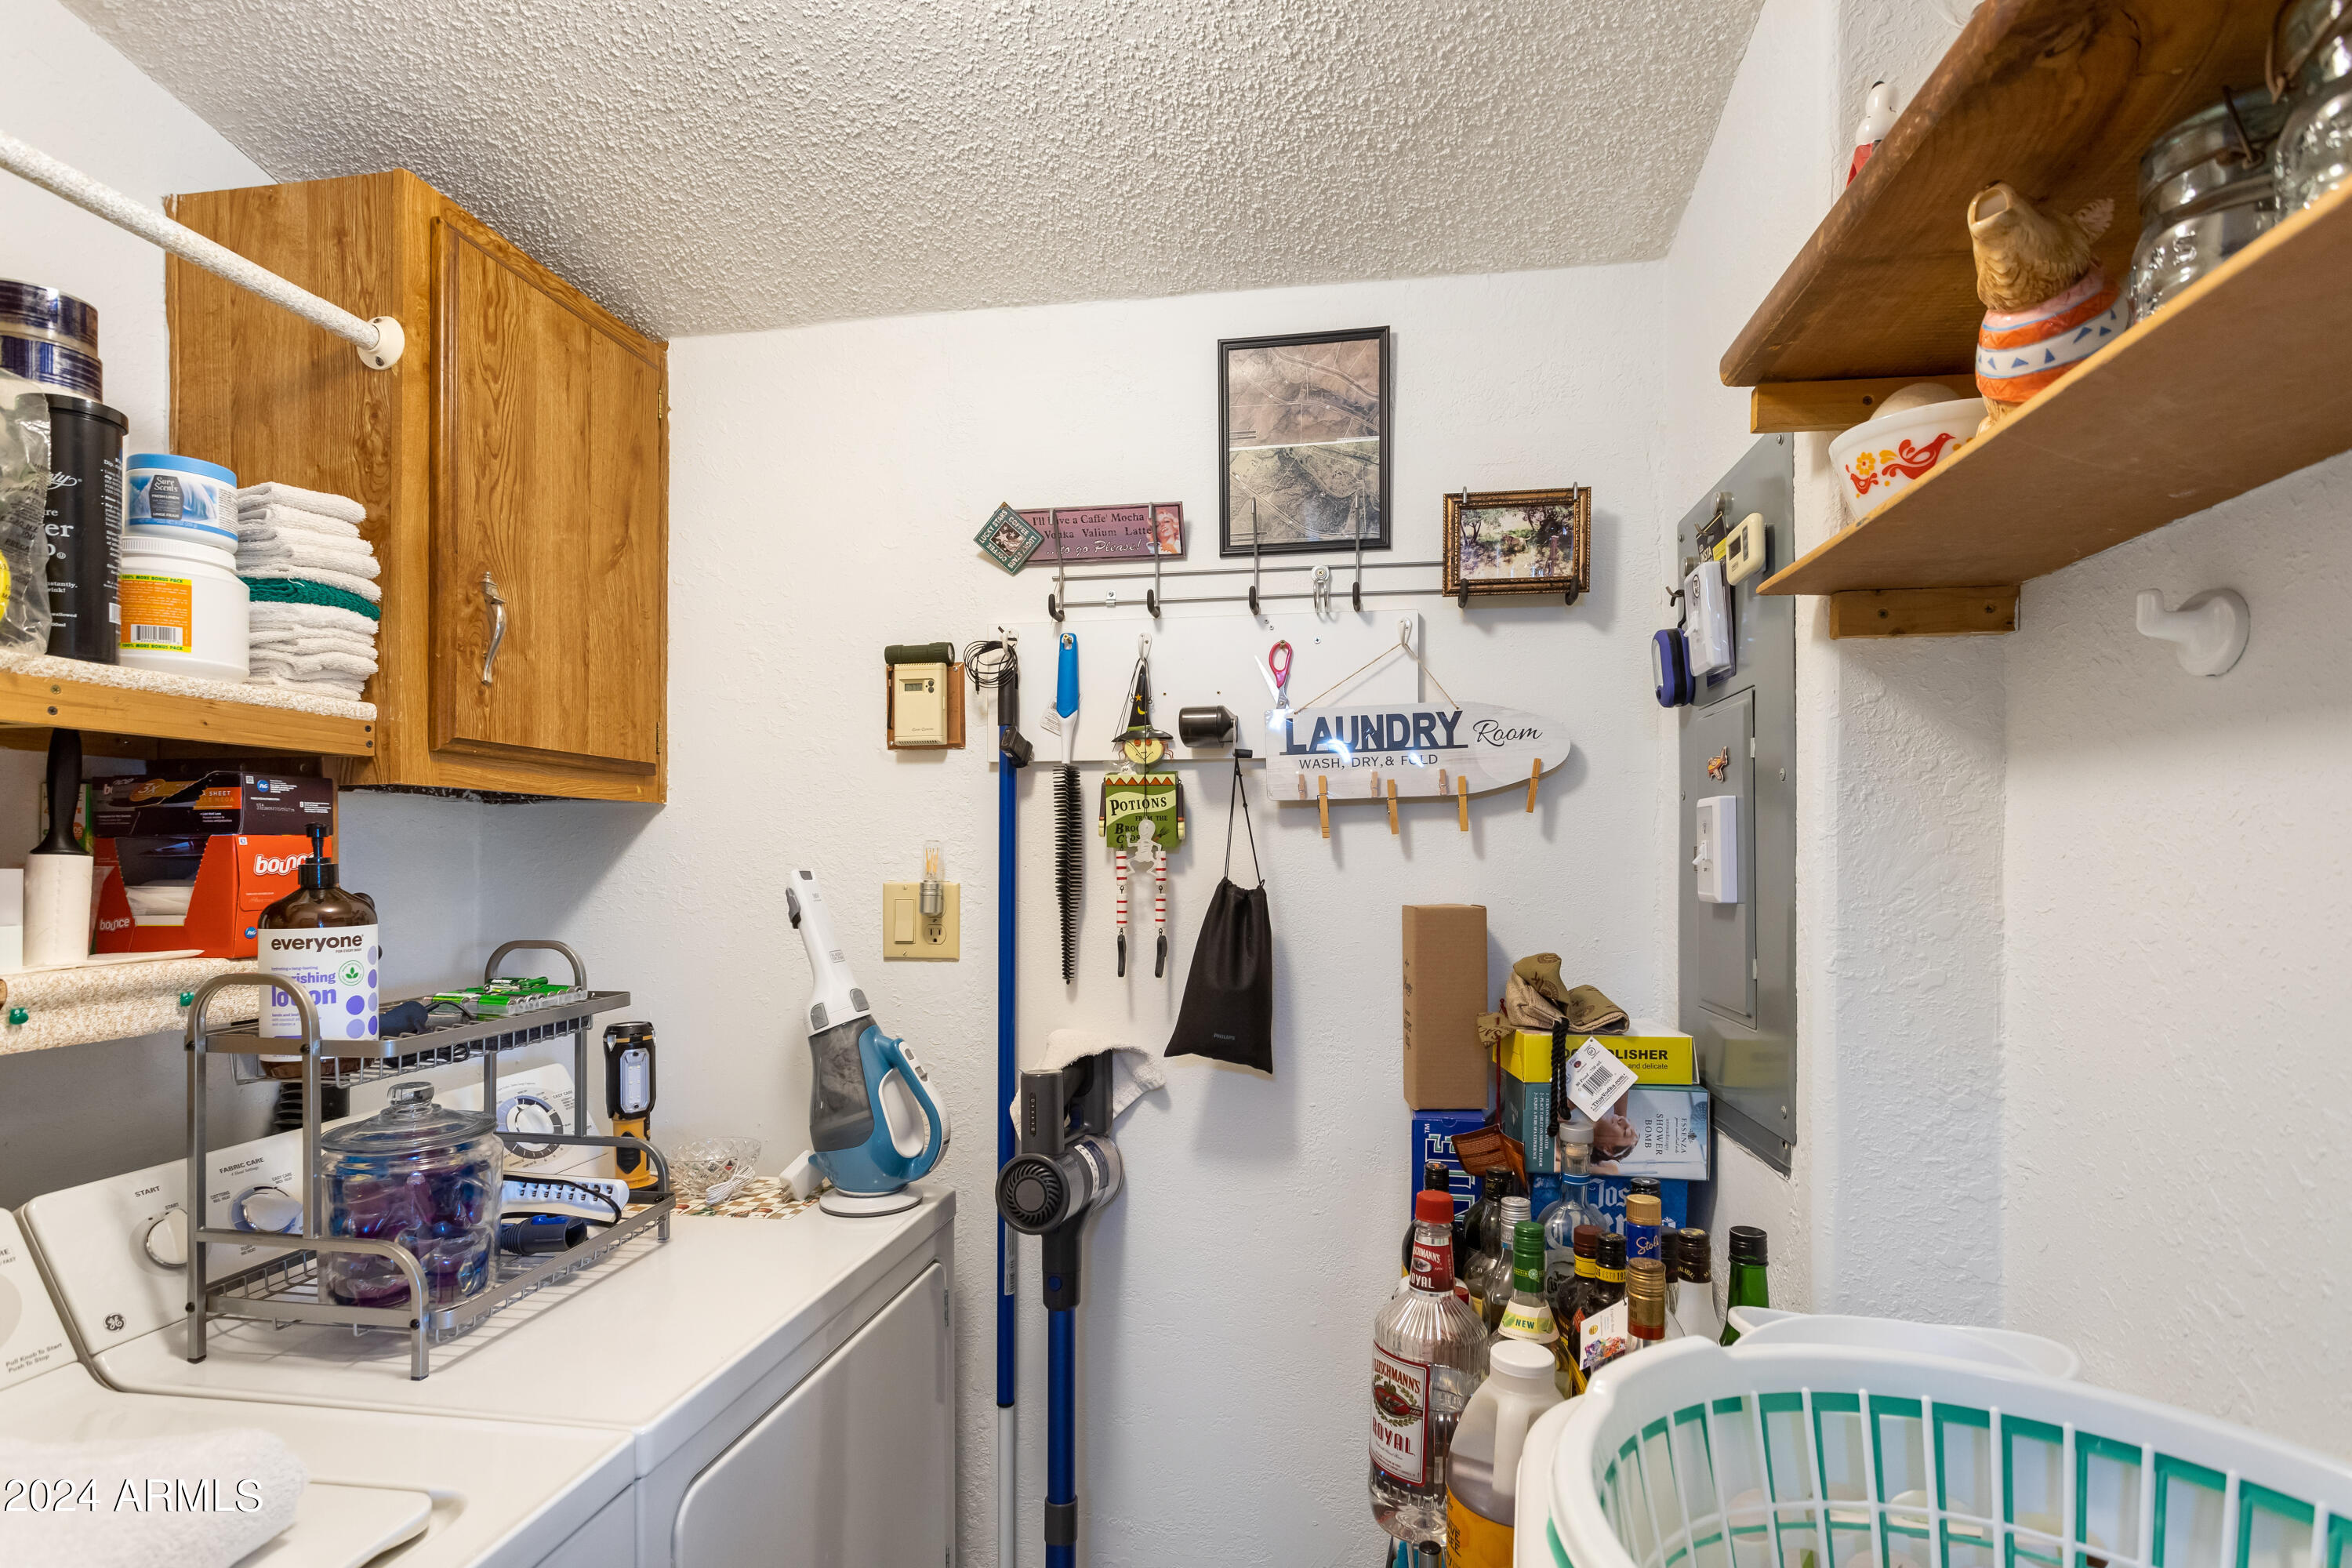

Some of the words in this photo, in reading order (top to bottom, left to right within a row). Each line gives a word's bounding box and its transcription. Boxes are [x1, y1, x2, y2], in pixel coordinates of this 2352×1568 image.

[154, 482, 179, 492] Scents
[157, 476, 175, 486] Sure
[978, 525, 994, 544] LUCKY
[992, 510, 1008, 528] STARS
[1008, 517, 1029, 536] COFFEE
[1033, 517, 1045, 527] I'll
[1080, 514, 1108, 524] Caffe'
[1111, 513, 1144, 523] Mocha
[1082, 528, 1117, 537] Valium
[1125, 527, 1152, 535] Latte
[986, 543, 1007, 562] COFFEE
[1022, 535, 1037, 554] LUCKY
[1076, 544, 1089, 557] go
[1094, 539, 1142, 554] Please!
[1007, 551, 1023, 569] STARS
[1285, 710, 1463, 753] LAUNDRY
[1472, 719, 1544, 747] Room
[1299, 757, 1345, 770] WASH,
[1109, 797, 1167, 816] POTIONS
[253, 852, 314, 876] boun
[100, 918, 131, 932] bounce
[271, 935, 363, 953] everyone
[271, 985, 337, 1007] loon
[1613, 1049, 1668, 1060] LISHER
[1644, 1120, 1653, 1149] BOMB
[1655, 1113, 1664, 1156] SHOWER
[220, 1162, 245, 1174] FABRIC
[246, 1157, 264, 1167] CARE
[135, 1185, 161, 1198] START
[1589, 1178, 1631, 1208] Jos
[165, 1202, 180, 1210] START
[1410, 1272, 1436, 1290] OYAL
[1515, 1318, 1535, 1330] NEW
[5, 1358, 19, 1367] Pull
[20, 1352, 38, 1363] Knob
[46, 1342, 63, 1352] Start
[9, 1364, 24, 1374] Push
[34, 1355, 50, 1363] Stop
